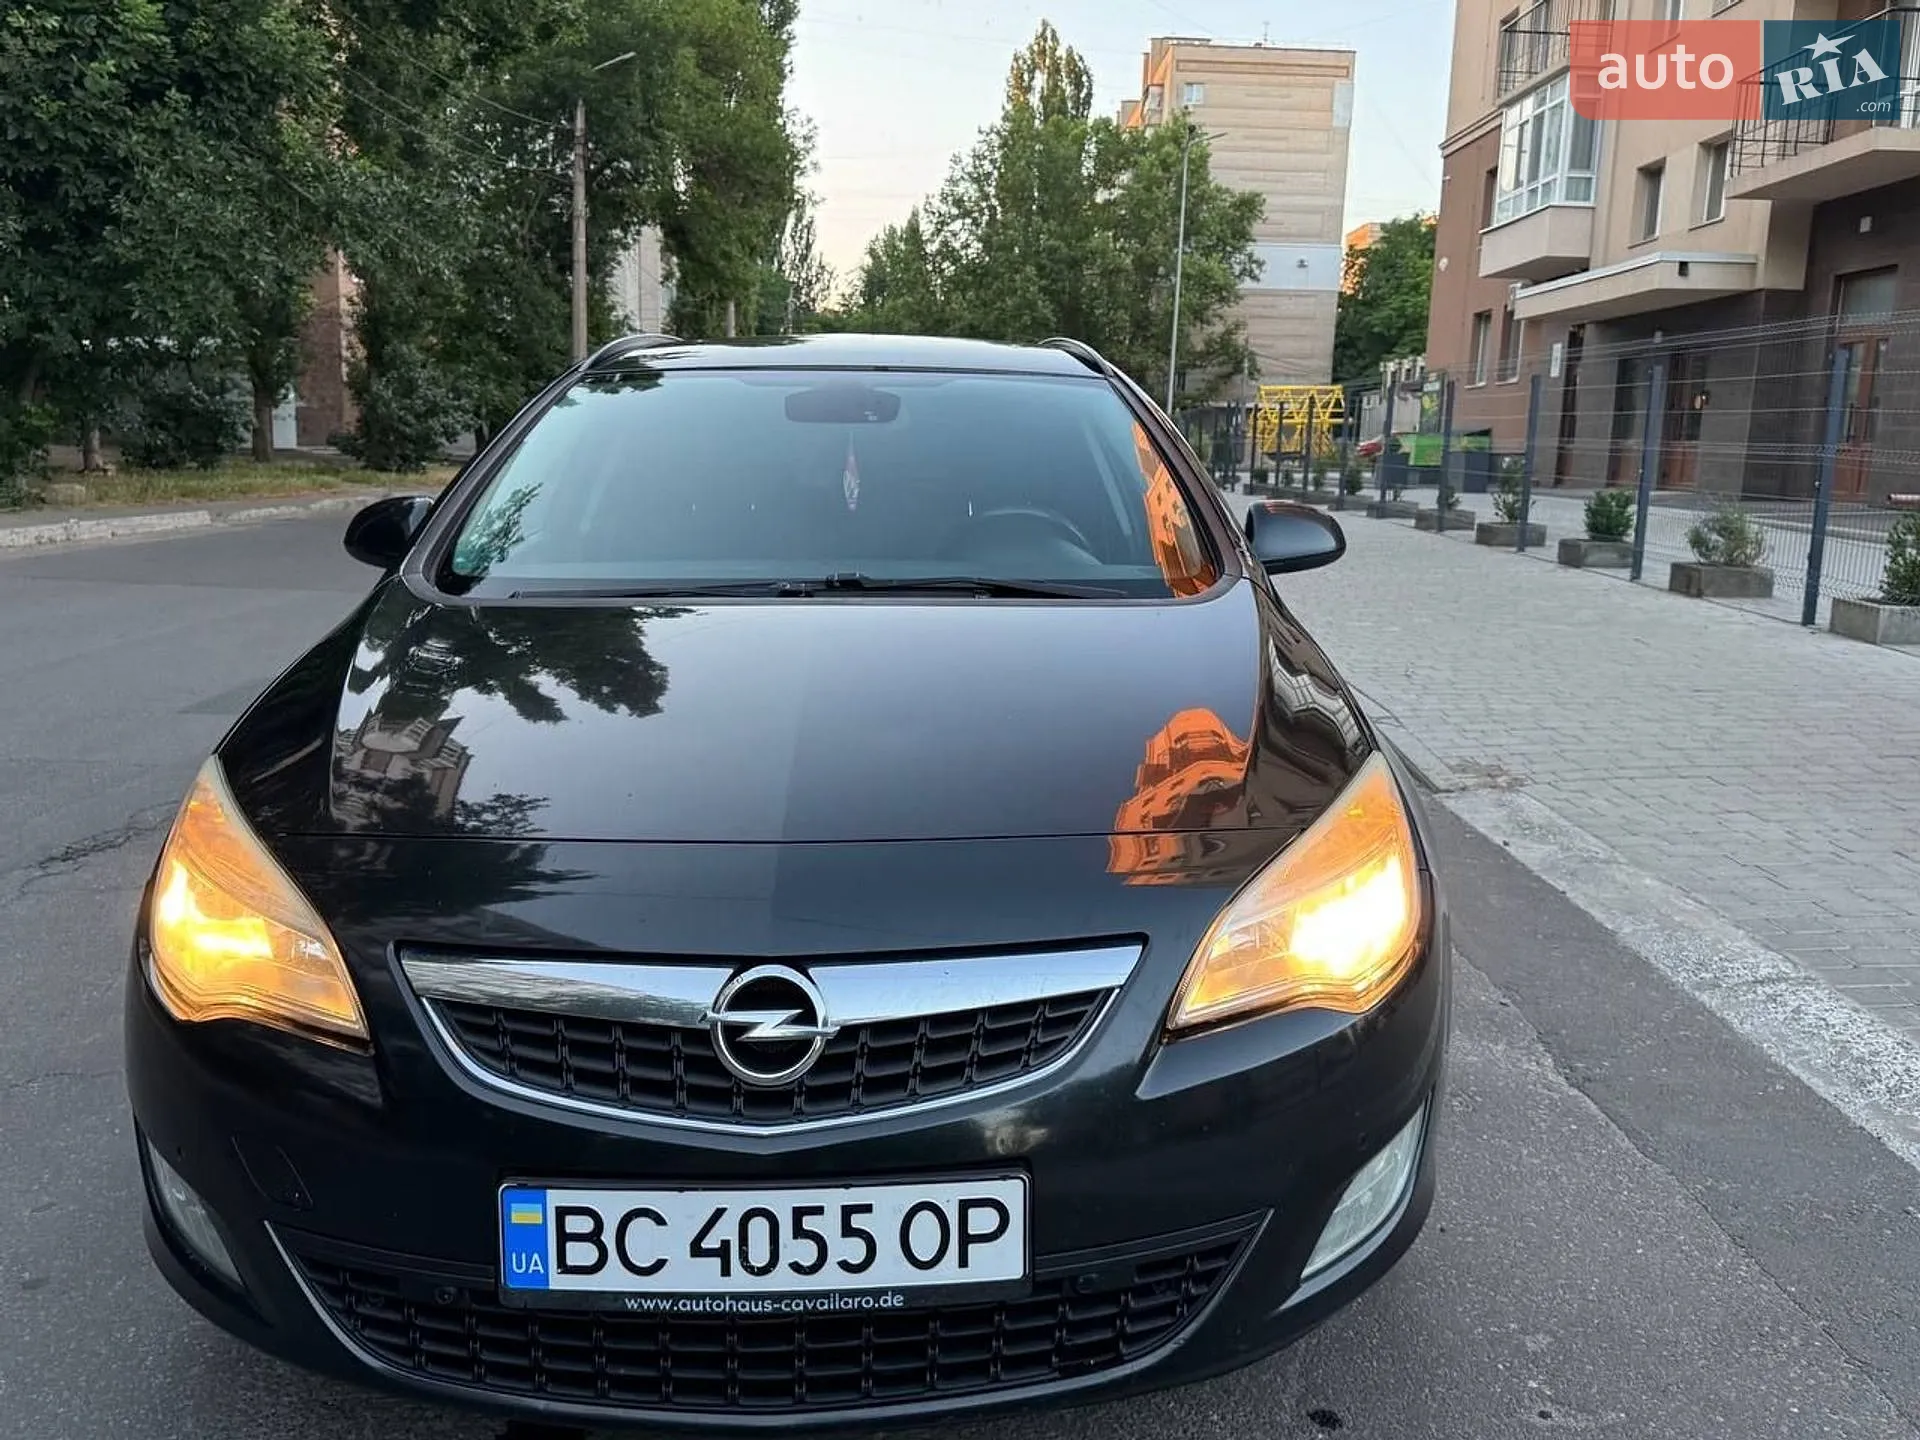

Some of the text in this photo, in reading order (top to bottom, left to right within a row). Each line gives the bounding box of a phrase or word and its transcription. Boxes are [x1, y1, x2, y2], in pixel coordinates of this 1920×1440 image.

[555, 1197, 1010, 1277] BC 4055 OP
[511, 1253, 544, 1274] UA
